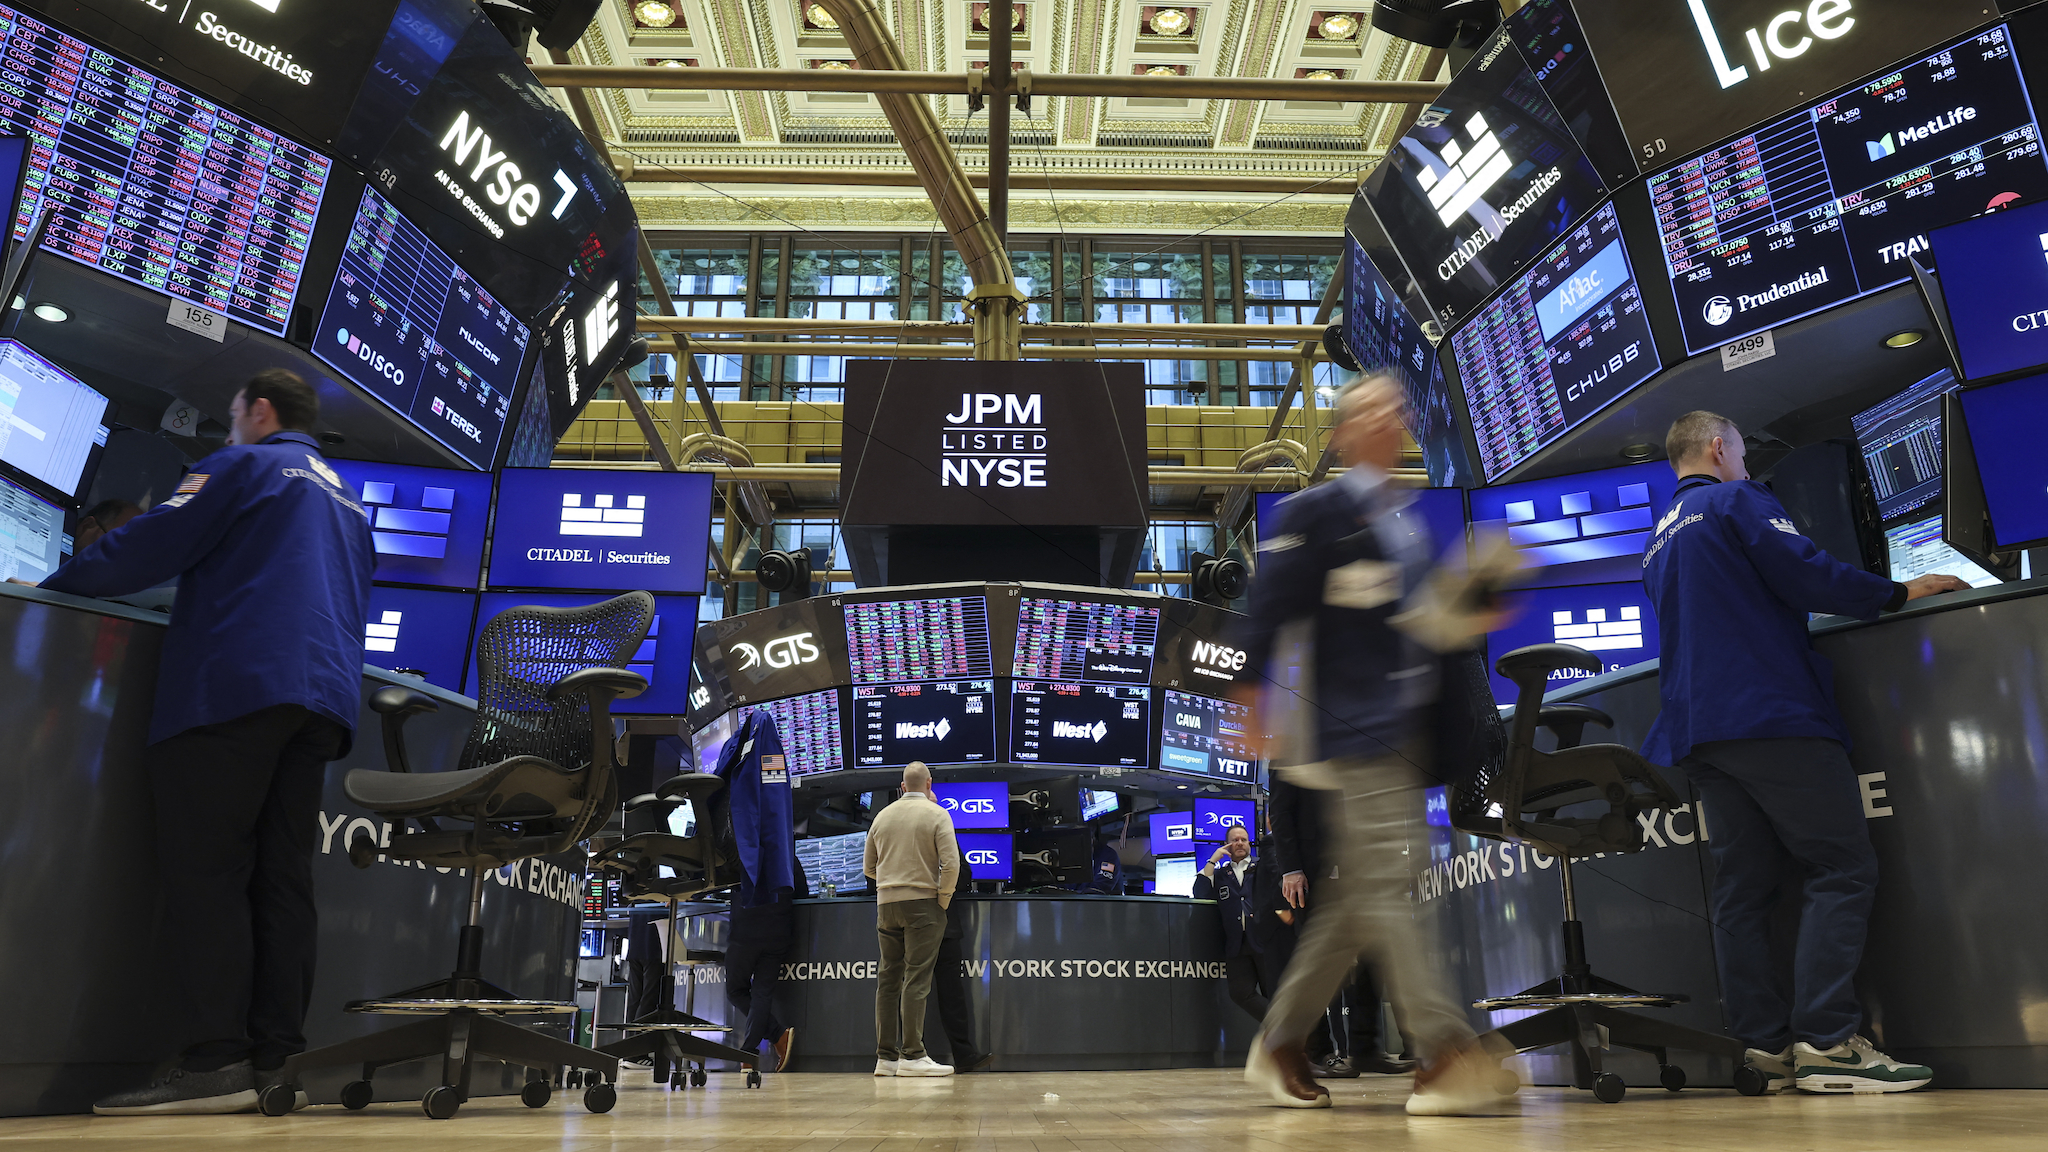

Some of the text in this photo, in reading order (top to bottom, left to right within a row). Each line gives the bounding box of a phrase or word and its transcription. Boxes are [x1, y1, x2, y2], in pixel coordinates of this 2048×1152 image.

[20, 17, 47, 34] CBNA
[16, 27, 39, 43] CBT
[1977, 29, 2003, 46] 78.68
[1992, 36, 2005, 45] 100
[195, 11, 313, 86] Securities
[1982, 44, 2008, 61] 78.31
[8, 49, 37, 66] CHGG
[91, 50, 114, 66] ERO
[1927, 51, 1951, 68] 78.53
[88, 61, 112, 76] EVAC
[1931, 67, 1956, 83] 78.88
[158, 82, 180, 98] GNK
[1869, 72, 1903, 93] 78.5900
[1882, 87, 1907, 103] 78.70
[152, 102, 175, 118] HAFN
[1817, 100, 1838, 116] MET
[1832, 107, 1861, 125] 74,350
[71, 113, 87, 125] FN
[220, 111, 241, 125] MAIN
[217, 120, 239, 136] MATX
[1897, 106, 1977, 147] MetLife
[2001, 126, 2033, 145] 280.69
[1703, 152, 1721, 164] USB
[1950, 147, 1980, 165] 280.40
[2006, 143, 2039, 161] 279.69
[272, 157, 292, 171] PRLB
[1705, 158, 1729, 173] UWMC
[1954, 163, 1985, 180] 281.48
[54, 166, 80, 182] FUBO
[202, 170, 222, 185] NUE
[434, 169, 451, 186] AN
[1651, 173, 1670, 186] RYAN
[1708, 170, 1728, 182] VOYA
[1891, 166, 1930, 187] 280.6300
[50, 177, 76, 192] GATX
[267, 177, 290, 191] QTWO
[1710, 179, 1732, 193] WCN
[1905, 182, 1934, 199] 281.29
[196, 190, 219, 206] NXDR
[264, 187, 282, 200] RBA
[1656, 192, 1675, 205] SMBK
[1713, 190, 1730, 202] WM
[1841, 192, 1864, 208] TRV
[1658, 203, 1674, 215] SSB
[1715, 199, 1736, 212] WSO
[1808, 203, 1835, 220] 117.17
[1858, 199, 1887, 217] 49,630
[117, 216, 140, 230] JOBY
[190, 211, 212, 225] ODV
[1437, 166, 1562, 281] CITADEL Securities
[1660, 212, 1676, 224] TFC
[113, 226, 135, 241] KEX
[253, 225, 273, 239] SMRT
[1663, 222, 1679, 234] TFIN
[1765, 220, 1791, 237] 116.90
[1812, 218, 1839, 235] 116.50
[109, 237, 134, 252] LAW
[1665, 231, 1681, 244] TRV
[1768, 235, 1795, 251] 117.14
[1667, 240, 1685, 253] UCB
[1716, 237, 1749, 256] 117.0750
[178, 252, 200, 266] PAAS
[1669, 249, 1689, 263] UNM
[1726, 252, 1752, 268] 117.14
[103, 259, 126, 274] LZM
[1673, 259, 1693, 272] PRU
[172, 272, 192, 287] PDS
[239, 276, 256, 289] TEX
[341, 270, 356, 286] LAW
[1687, 266, 1712, 283] 28,332
[168, 283, 191, 297] SKYH
[236, 286, 257, 299] TFPM
[1736, 266, 1830, 313] Prudential
[1575, 287, 1604, 313] Incorporated
[185, 307, 213, 326] 155
[459, 326, 501, 366] NUCOR
[1728, 336, 1764, 357] 2499
[359, 342, 405, 385] DISCO
[1566, 342, 1639, 402] CHUBB
[945, 393, 1042, 424] JPM
[943, 434, 1047, 450] LISTED
[941, 458, 1047, 487] NYSE
[526, 548, 671, 565] CITADEL Securities
[1008, 589, 1019, 597] 8P
[763, 632, 820, 669] GTS
[858, 687, 876, 696] WST
[1017, 682, 1035, 691] WST
[1175, 713, 1201, 729] CAVA
[895, 721, 935, 739] West
[1052, 721, 1092, 738] West
[1169, 752, 1203, 764] sweetgreen
[1217, 757, 1249, 776] YETI
[1417, 863, 1442, 904] NEW
[1444, 845, 1497, 892] YORK
[693, 966, 721, 985] YORK
[993, 959, 1056, 978] YORK
[1060, 959, 1130, 978] STOCK
[1134, 960, 1228, 979] EXCHANGE
